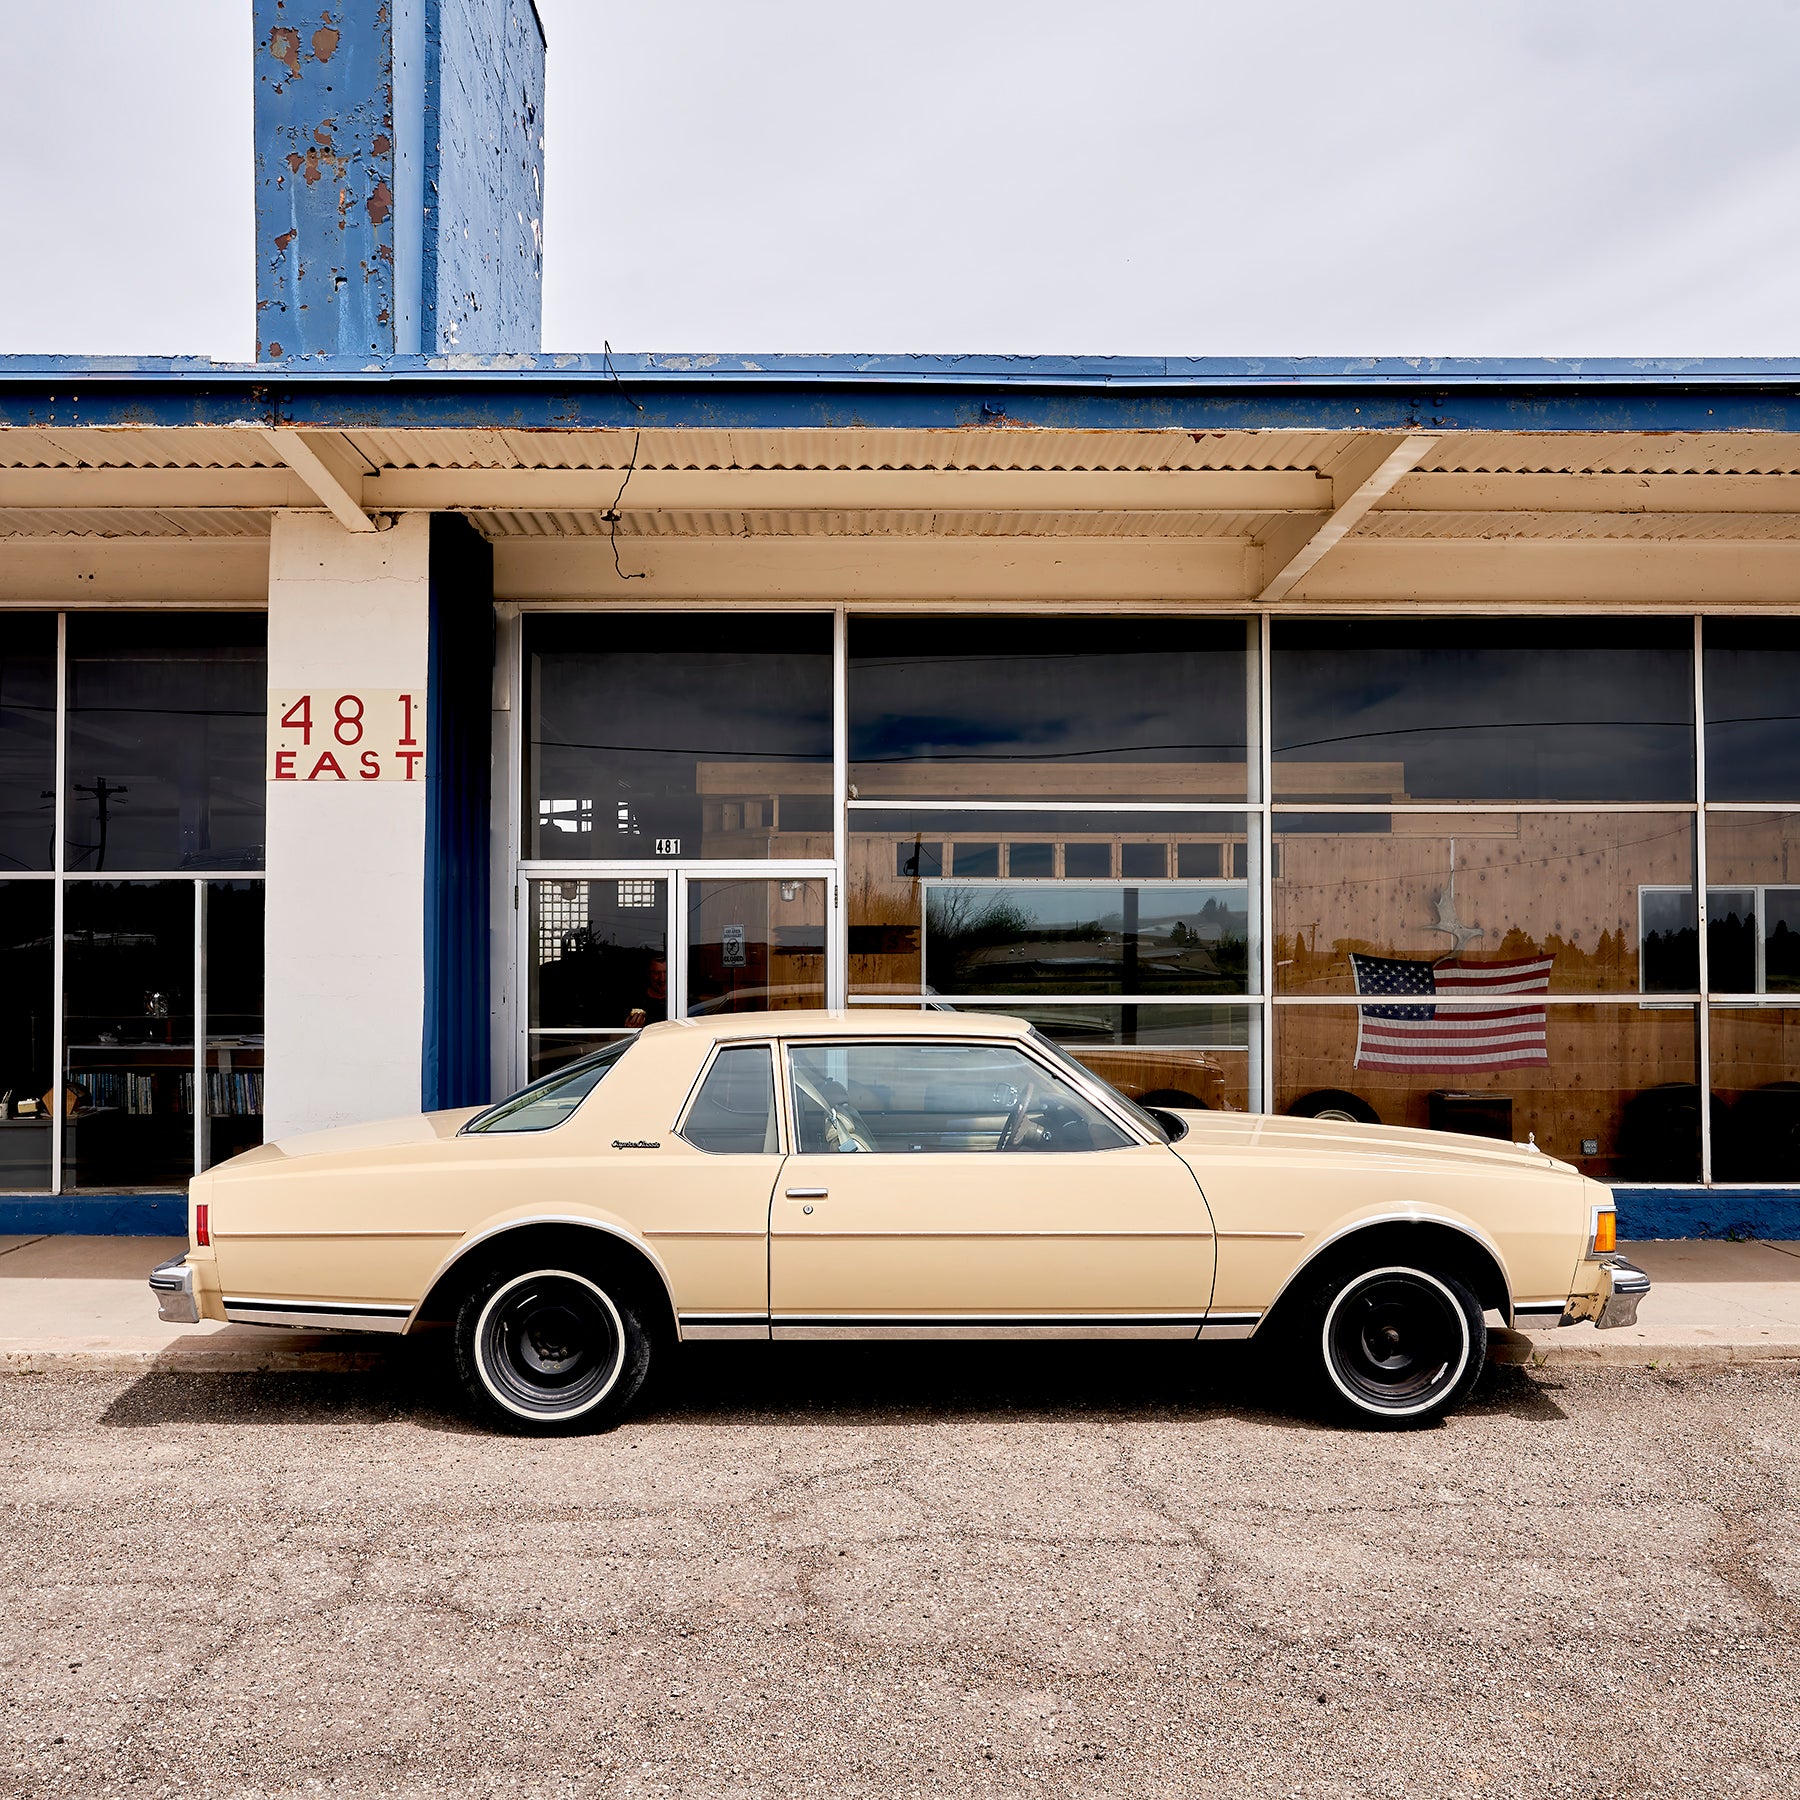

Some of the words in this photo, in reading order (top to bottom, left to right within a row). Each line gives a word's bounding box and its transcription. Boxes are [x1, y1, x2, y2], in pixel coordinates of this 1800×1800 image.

[281, 694, 417, 746] 481
[275, 750, 424, 780] EAST
[657, 839, 679, 853] 481
